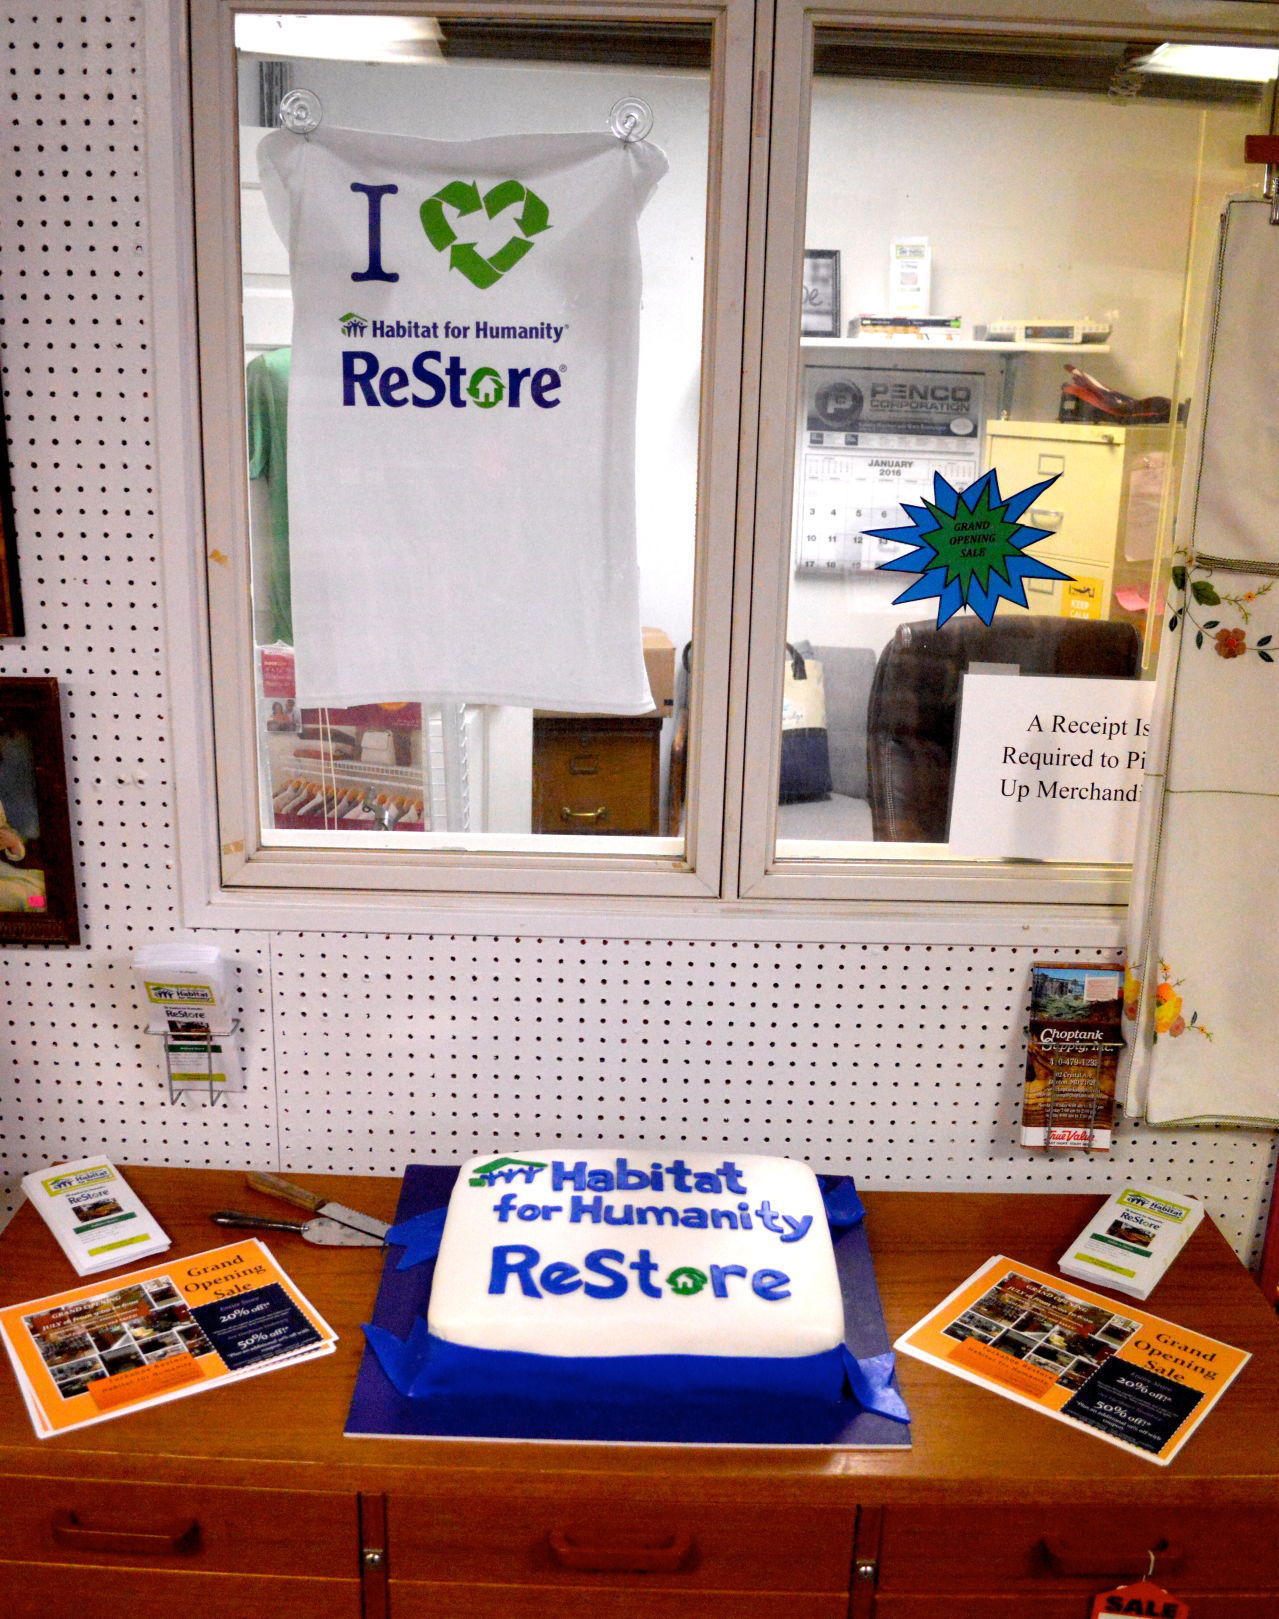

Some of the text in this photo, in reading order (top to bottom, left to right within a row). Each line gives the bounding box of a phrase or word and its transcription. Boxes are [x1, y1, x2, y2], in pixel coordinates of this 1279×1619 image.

[350, 182, 399, 283] I
[372, 320, 564, 343] Habitat for Humanity
[341, 350, 562, 409] ReStore
[870, 382, 971, 401] PENCO
[870, 399, 970, 412] CORPORATION
[868, 459, 913, 469] JANUARY
[809, 508, 816, 516] 3
[830, 508, 837, 516] 4
[855, 509, 862, 518] 5
[954, 520, 990, 531] GRAND
[853, 536, 863, 544] 12
[949, 533, 996, 545] OPENING
[960, 548, 986, 558] SALE
[1027, 714, 1150, 740] A Receipt Is
[1002, 746, 1093, 770] Required
[1100, 752, 1119, 769] to
[1000, 779, 1142, 802] Up Merchand
[1040, 1028, 1104, 1042] Choptank
[551, 1157, 748, 1195] Habitat
[493, 1193, 814, 1243] for Humanity
[187, 1254, 245, 1277] Grand
[488, 1244, 792, 1300] ReStore
[184, 1265, 266, 1292] Opening
[214, 1283, 252, 1298] Sale
[219, 1307, 250, 1323] 20%
[238, 1332, 268, 1349] 50%
[1156, 1333, 1216, 1362] Grand
[1134, 1340, 1218, 1380] Opening
[1144, 1360, 1185, 1380] Sale
[1116, 1377, 1148, 1394] 20%
[1095, 1401, 1127, 1418] 50%
[1105, 1595, 1178, 1619] SALE
